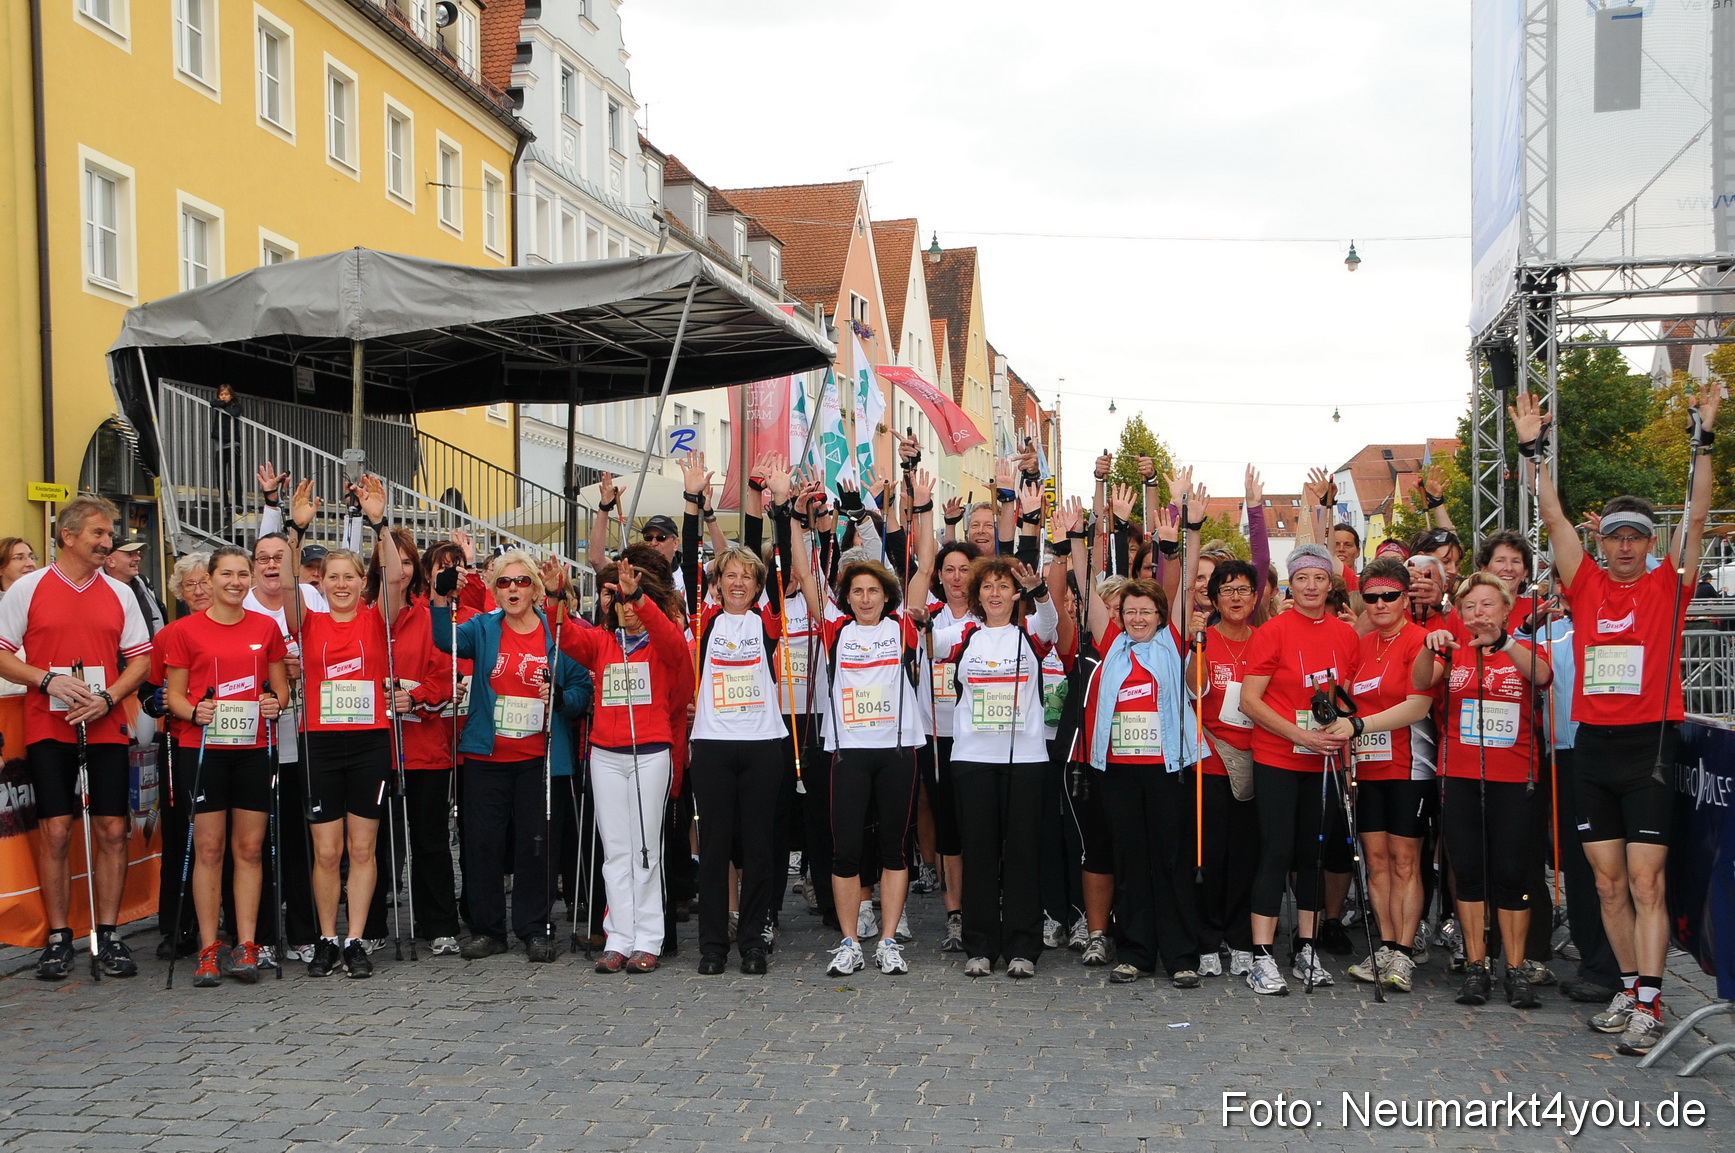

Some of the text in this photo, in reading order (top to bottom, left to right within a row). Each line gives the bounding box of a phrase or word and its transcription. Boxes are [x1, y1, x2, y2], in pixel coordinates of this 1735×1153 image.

[670, 428, 697, 454] R
[1597, 649, 1628, 659] Richard
[336, 663, 352, 673] DEHN
[612, 665, 638, 675] Manela
[1597, 663, 1637, 678] 8089
[726, 673, 754, 683] Theresia
[228, 682, 245, 691] DEHN
[335, 683, 357, 692] Nicole
[613, 678, 645, 691] 8080
[727, 685, 761, 699] 8036
[855, 690, 870, 698] Katy
[986, 692, 1015, 701] Gerlinde
[1127, 688, 1143, 697] DEHN
[336, 696, 370, 709] 8088
[506, 698, 528, 708] Priska
[857, 700, 891, 715] 8045
[220, 703, 244, 713] Carina
[221, 717, 255, 730] 8057
[506, 711, 539, 726] 8013
[1123, 714, 1147, 724] Monika
[1124, 728, 1158, 741] 8085
[1357, 733, 1387, 747] 8056
